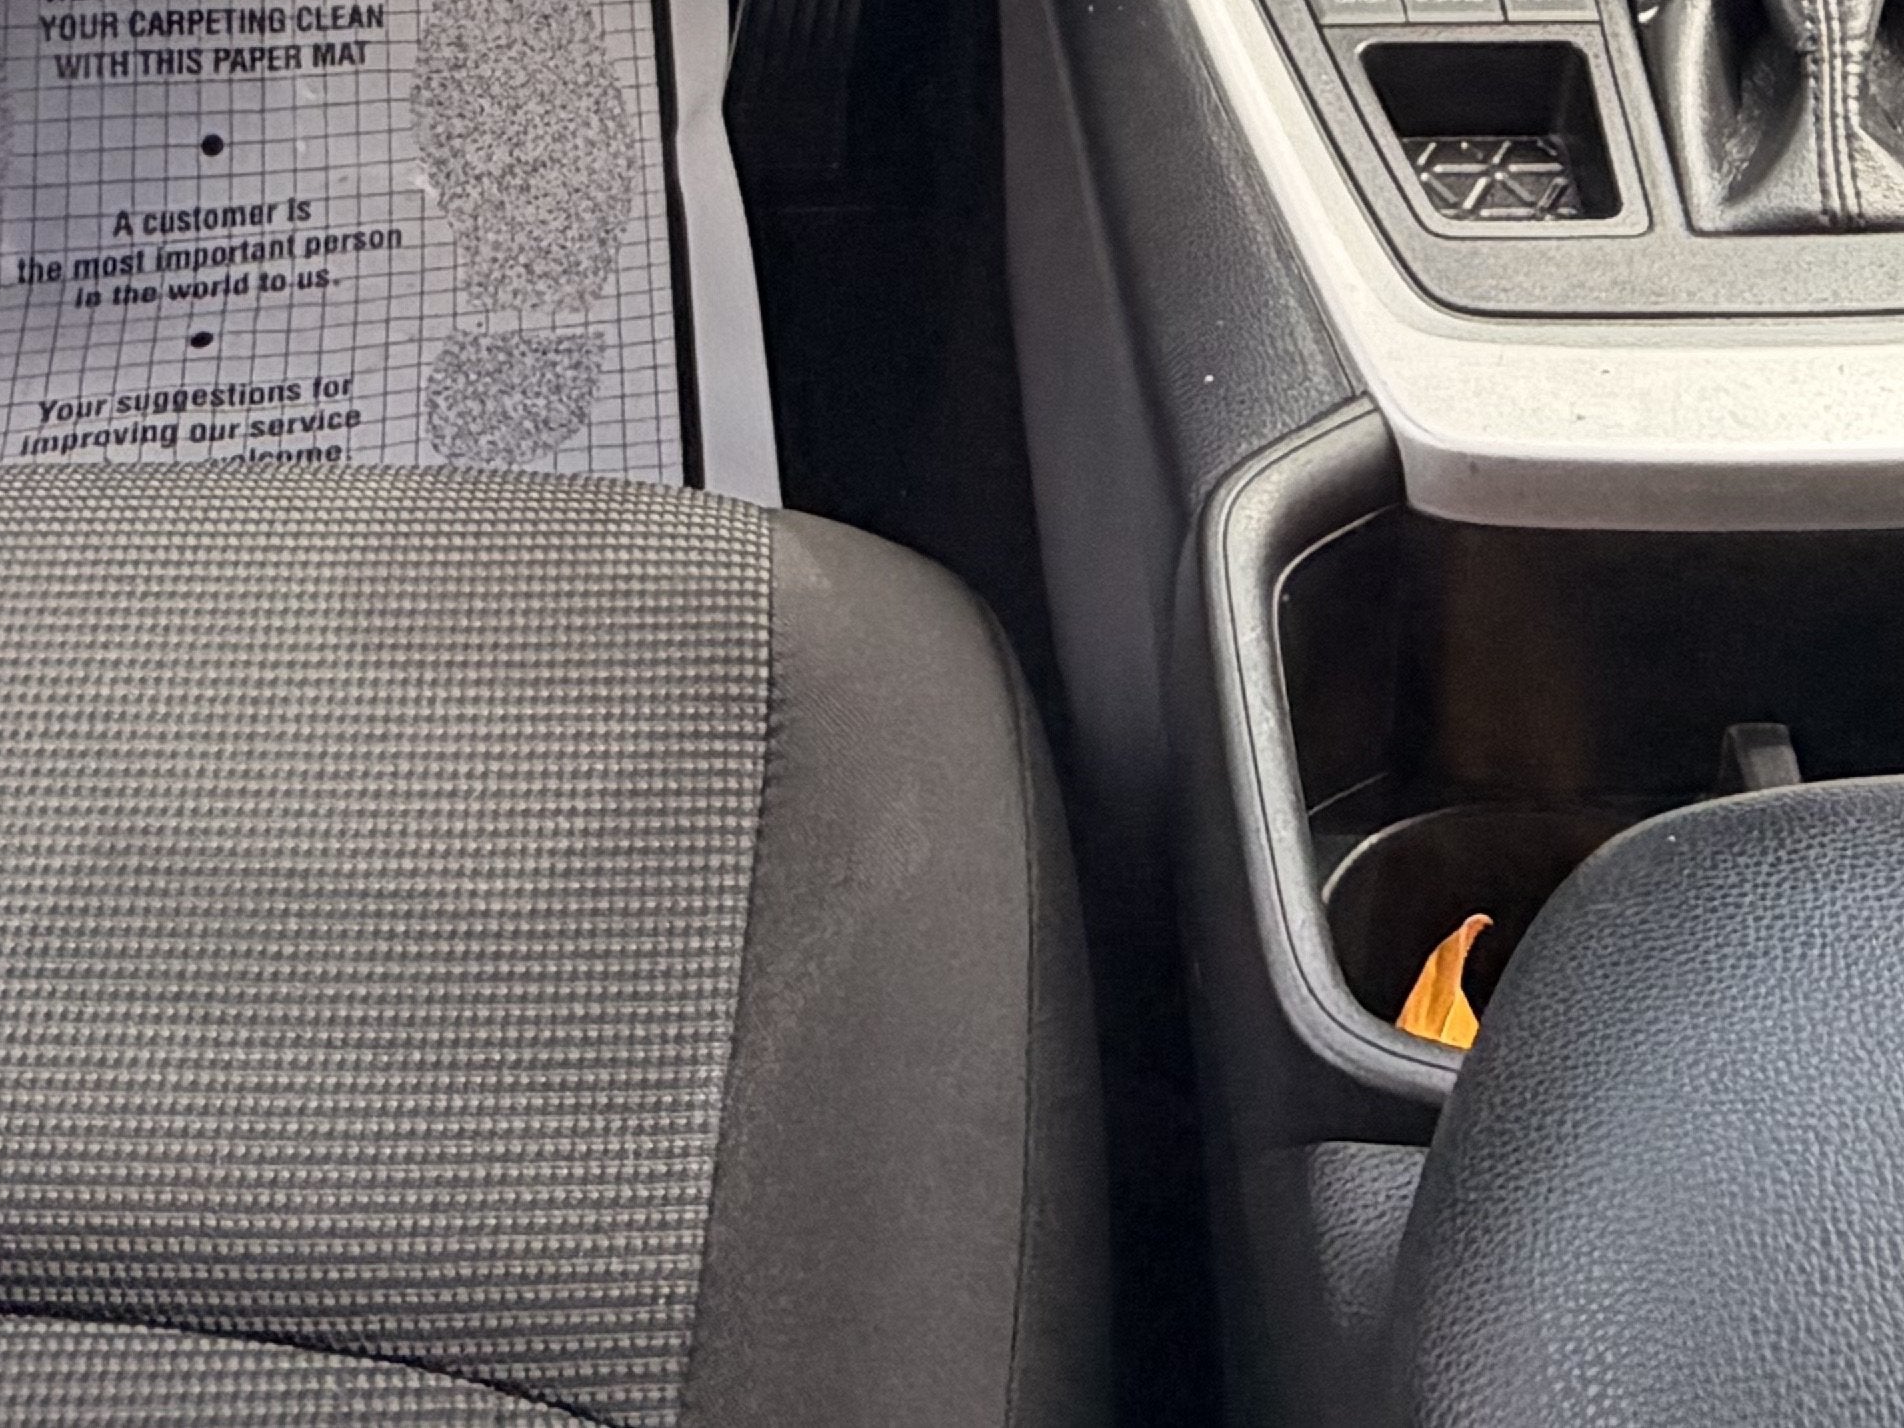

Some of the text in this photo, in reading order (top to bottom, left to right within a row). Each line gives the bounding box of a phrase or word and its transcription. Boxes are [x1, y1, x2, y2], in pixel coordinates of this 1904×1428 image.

[40, 3, 385, 42] YOUR CARPETING CLEAN
[55, 40, 371, 80] WITH THIS PAPER MAT
[113, 210, 134, 238] A
[143, 201, 279, 236] customer
[17, 227, 403, 284] the most important person
[112, 283, 158, 306] the
[168, 271, 250, 301] world
[259, 271, 287, 293] to
[297, 266, 341, 290] us.
[37, 376, 353, 424] Your suggestions for
[20, 407, 362, 457] improving our service
